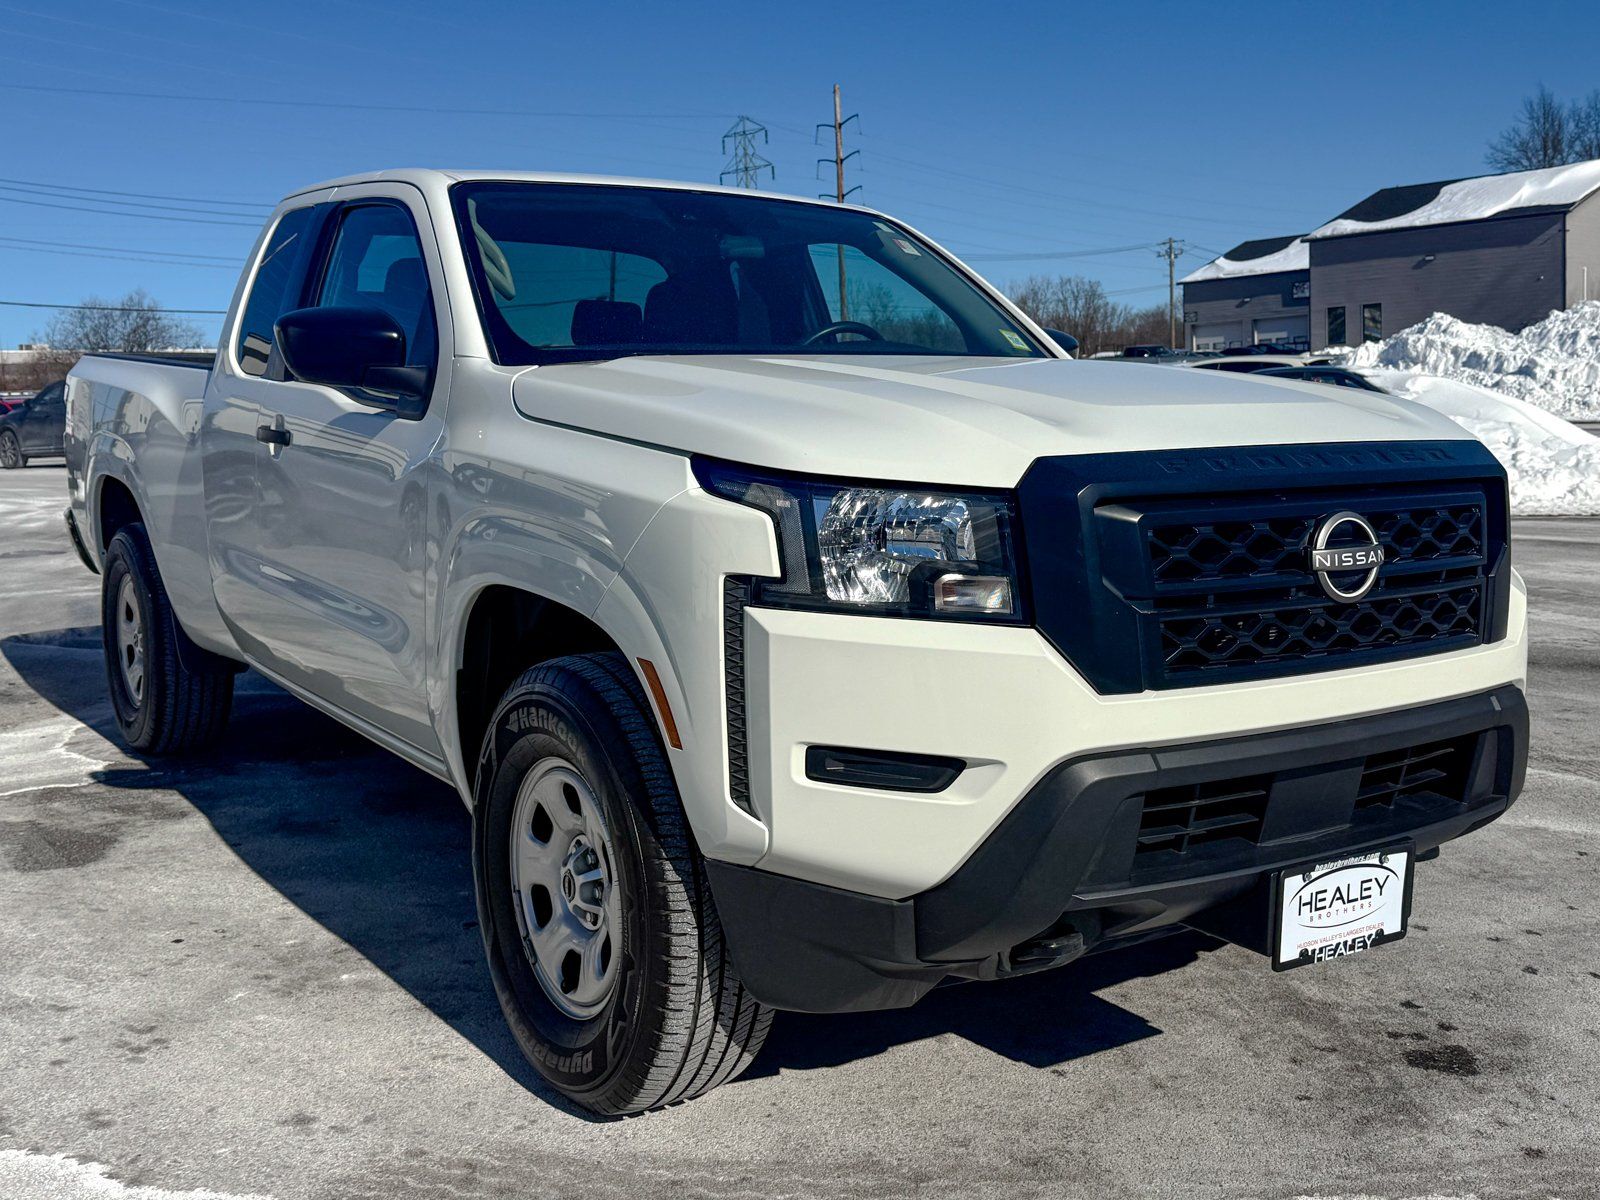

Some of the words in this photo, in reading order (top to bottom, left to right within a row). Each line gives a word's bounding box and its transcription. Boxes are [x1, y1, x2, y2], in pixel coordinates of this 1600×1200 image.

[1315, 549, 1384, 568] NISSAN
[1314, 852, 1381, 872] healeybrothers.com
[1298, 874, 1390, 916] HEALEY
[1309, 901, 1373, 923] BROTHERS
[1296, 938, 1319, 949] HUDSON
[1319, 932, 1343, 944] VALLEY'S
[1343, 926, 1365, 938] LARGEST
[1365, 921, 1385, 932] DEALER
[1314, 935, 1374, 964] HEALEY
